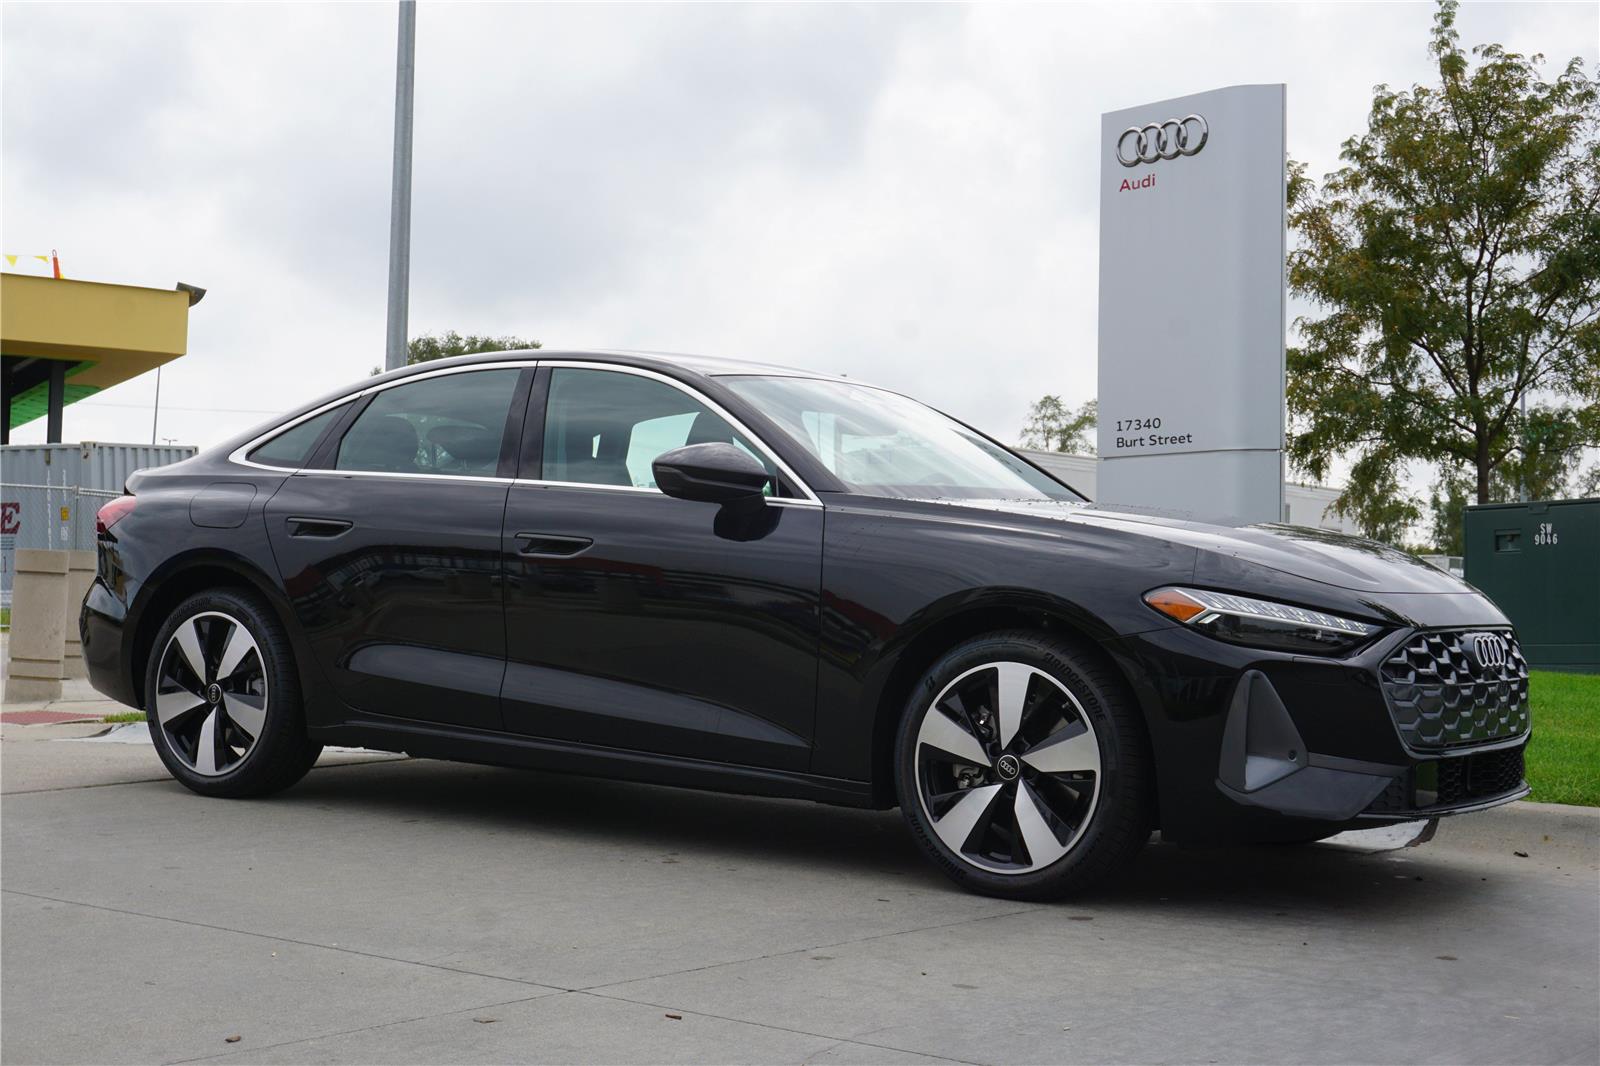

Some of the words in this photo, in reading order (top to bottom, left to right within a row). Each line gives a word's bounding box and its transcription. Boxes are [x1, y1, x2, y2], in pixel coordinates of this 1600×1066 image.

[1119, 173, 1156, 192] Audi
[1116, 417, 1161, 432] 17340
[1116, 436, 1145, 448] Burt
[1149, 433, 1193, 446] Street
[1540, 522, 1553, 534] SW
[1534, 534, 1558, 546] 9046
[1042, 652, 1108, 722] BRIDGESTONE
